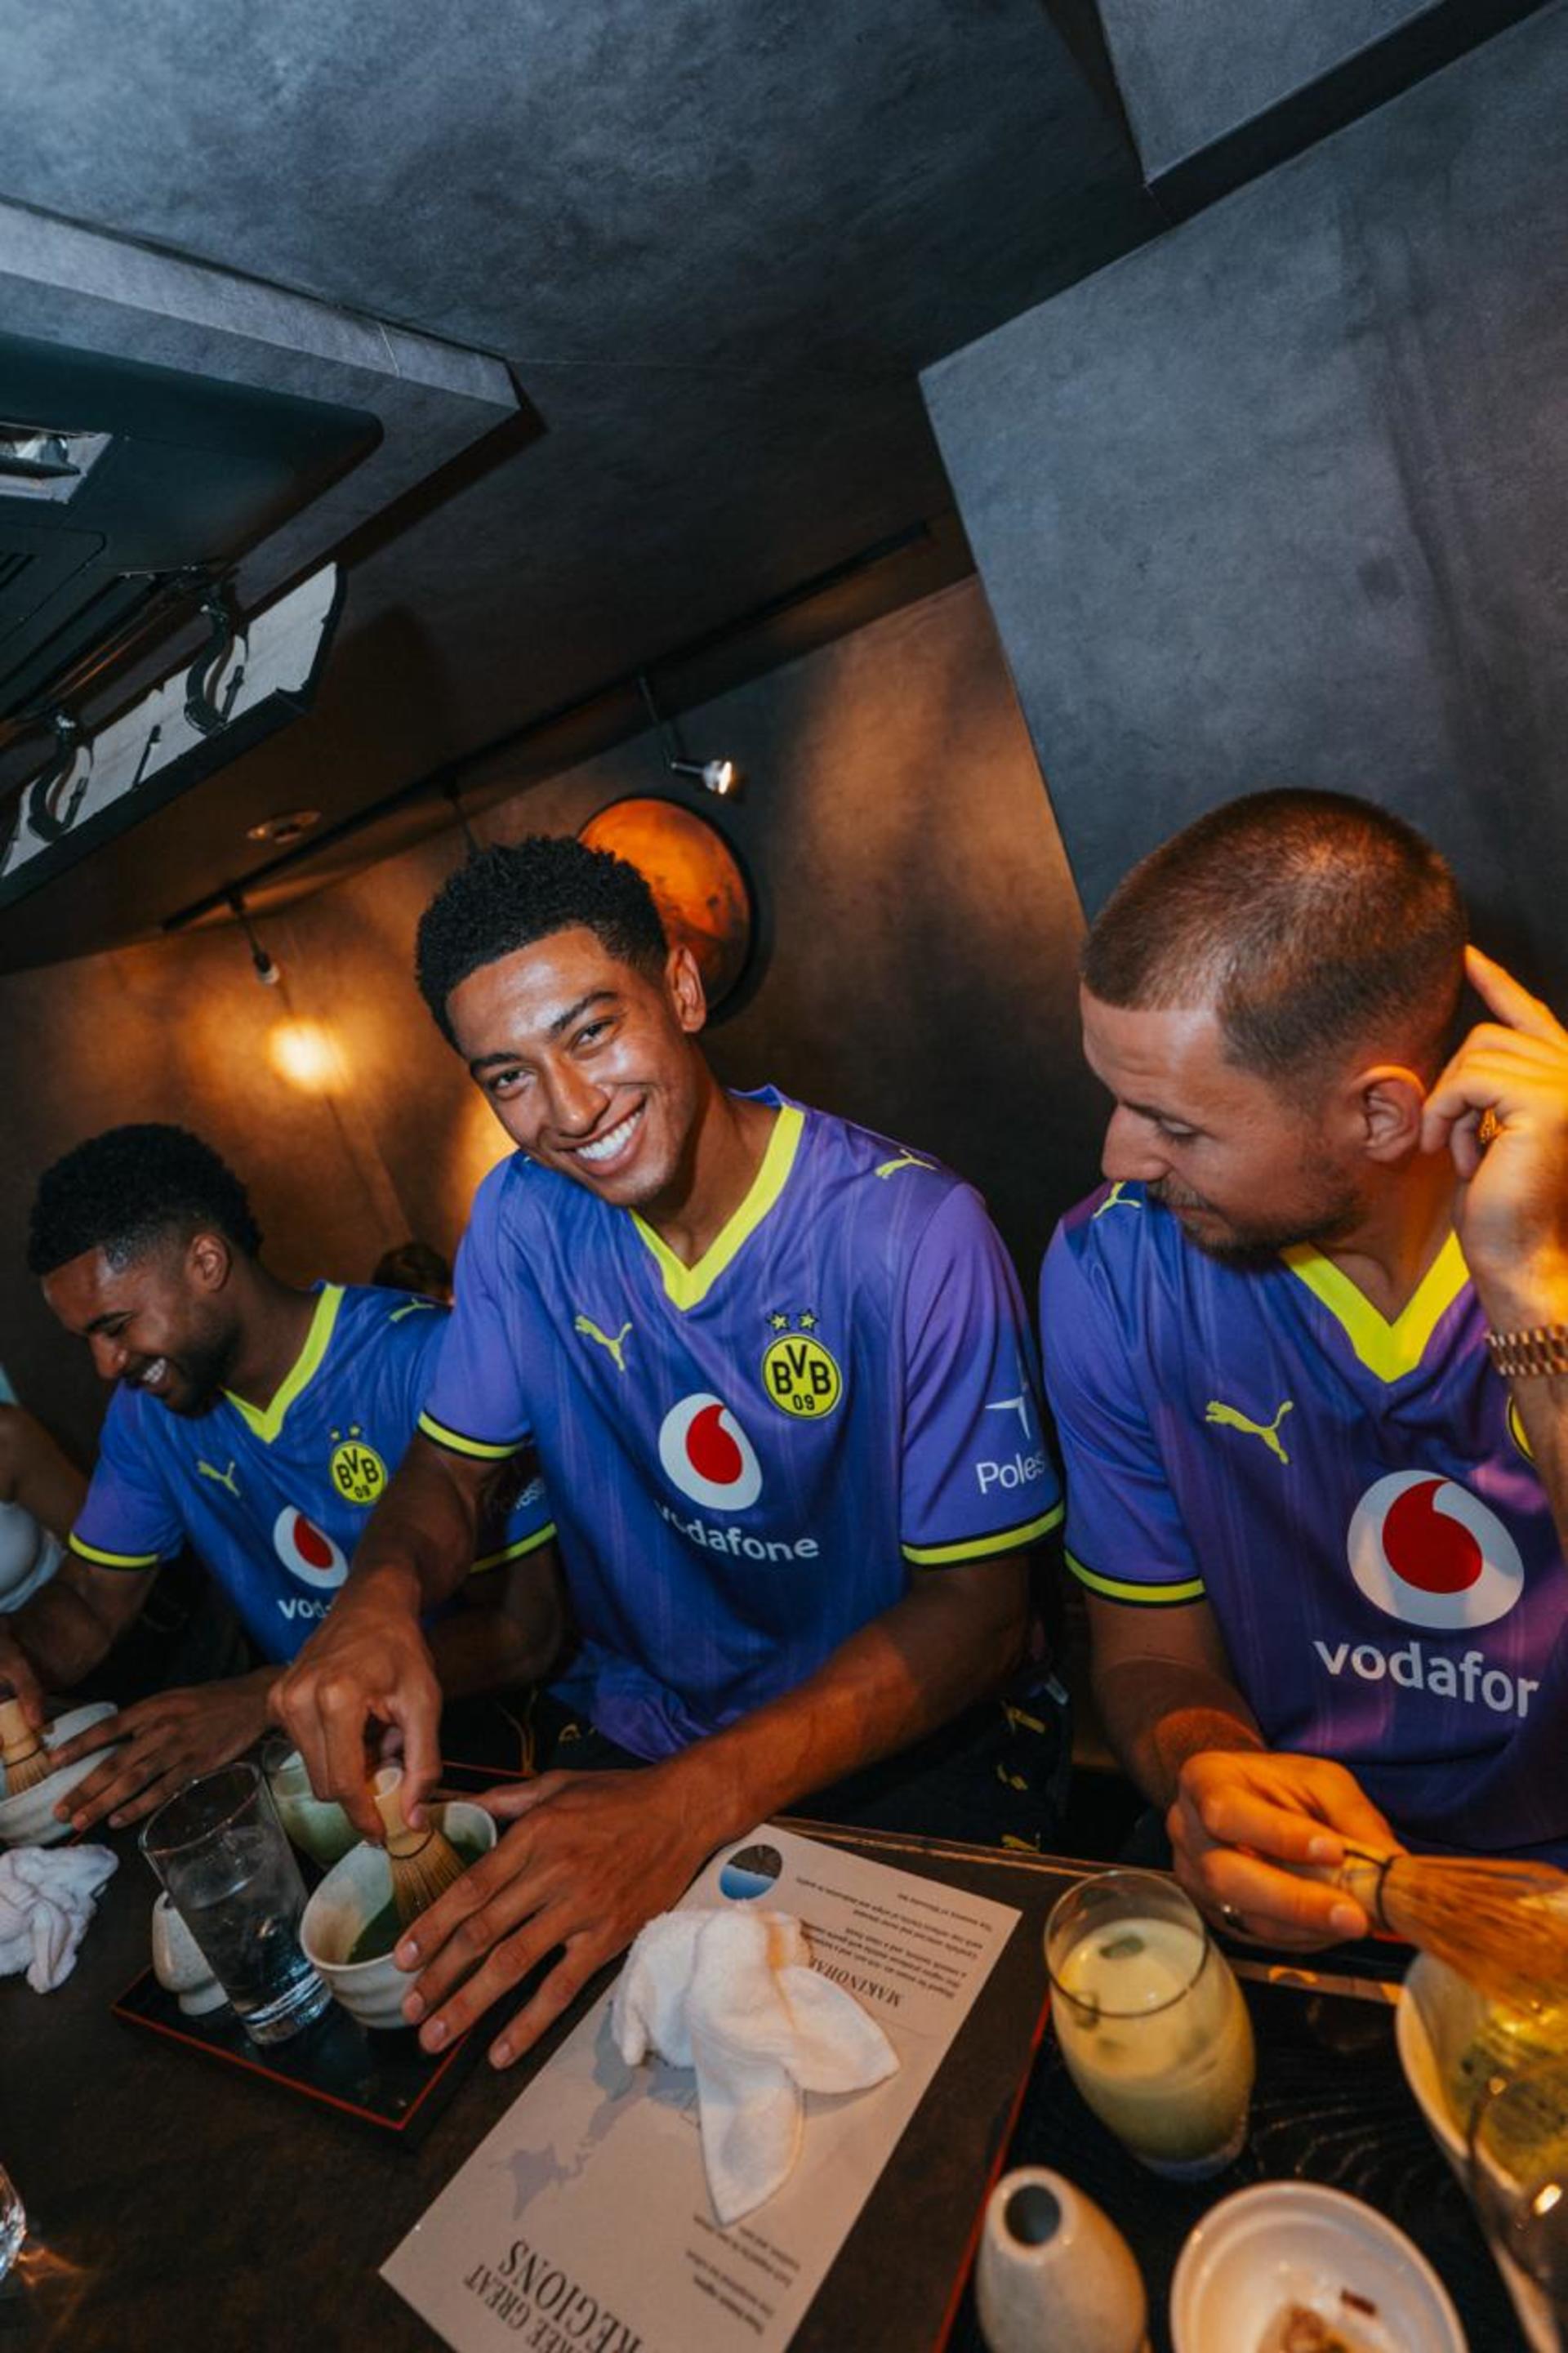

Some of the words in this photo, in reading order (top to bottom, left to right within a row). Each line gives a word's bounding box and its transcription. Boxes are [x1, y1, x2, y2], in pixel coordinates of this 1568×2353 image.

[772, 1344, 831, 1396] BVB
[792, 1393, 816, 1411] 09
[336, 1448, 380, 1490] BVB
[462, 2264, 531, 2330] GREAT
